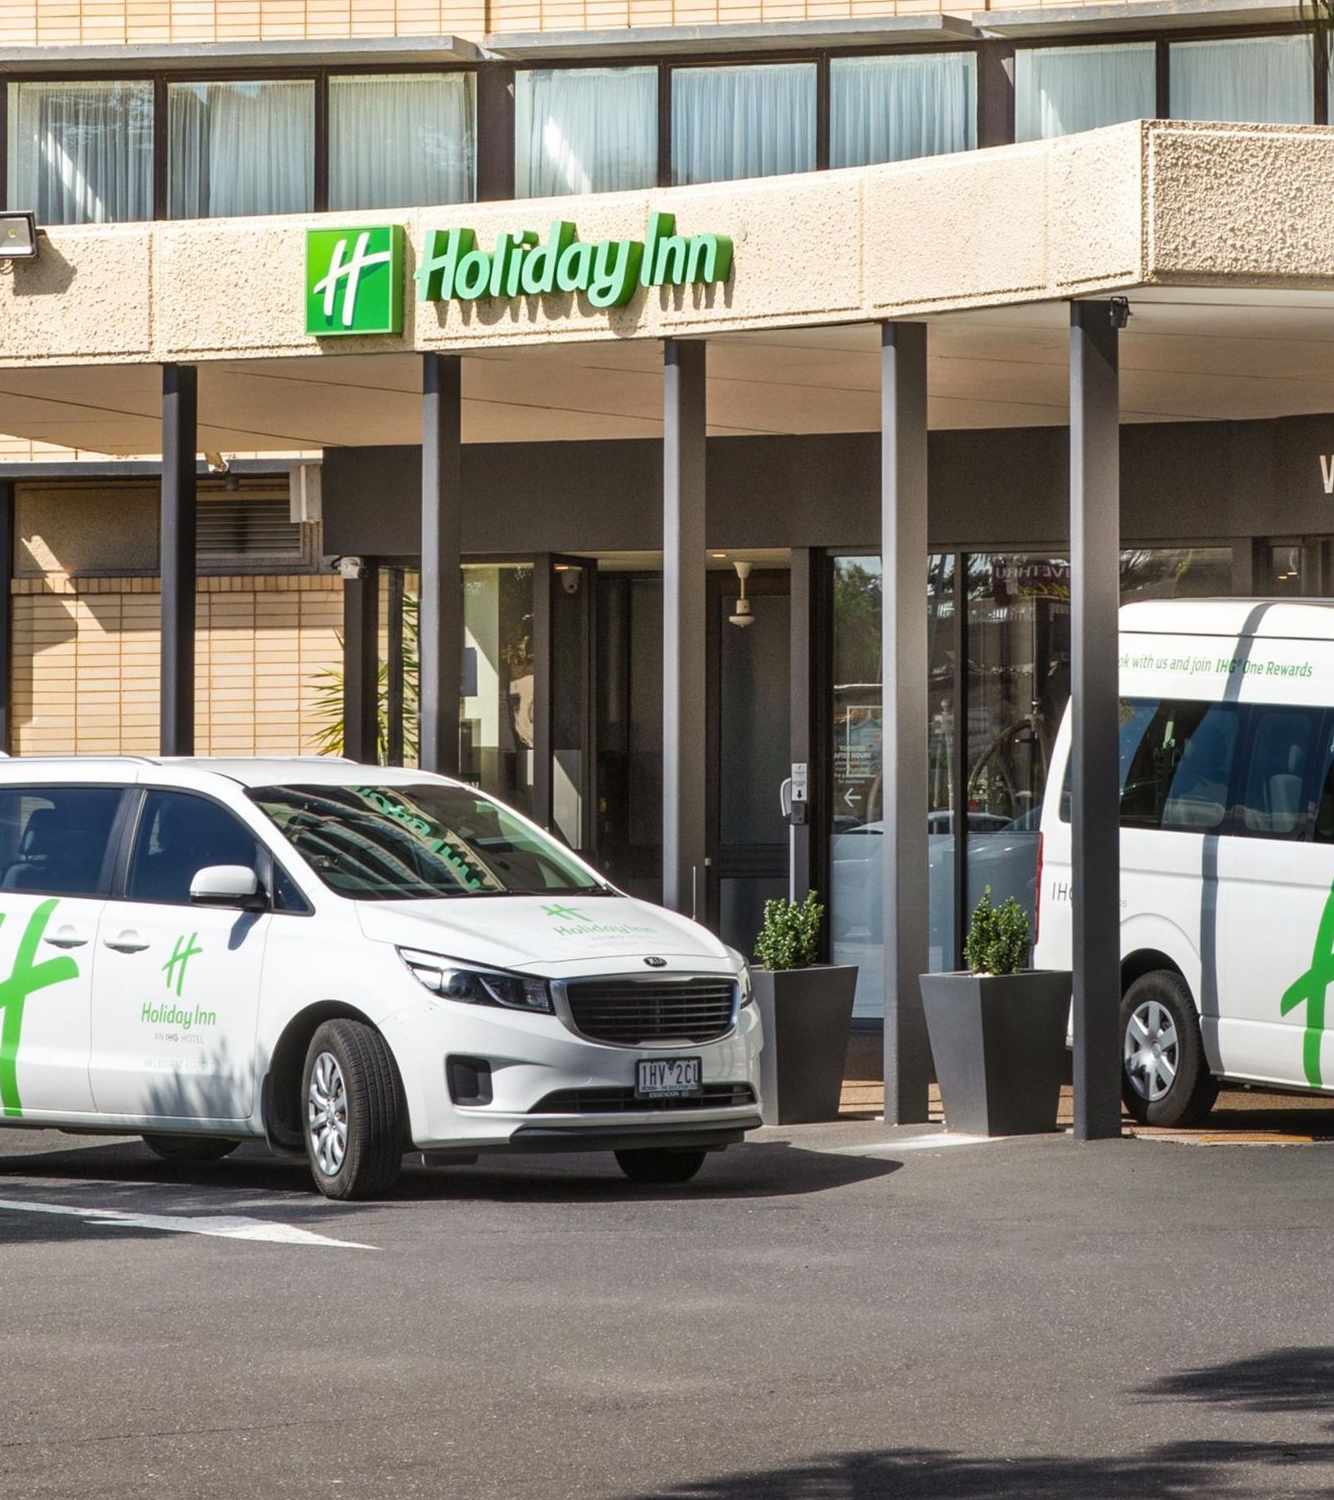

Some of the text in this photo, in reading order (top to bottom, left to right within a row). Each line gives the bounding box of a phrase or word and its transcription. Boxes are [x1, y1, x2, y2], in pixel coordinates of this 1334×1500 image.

[414, 220, 642, 308] Holiday
[640, 211, 733, 288] Inn
[1118, 654, 1130, 669] ok
[1133, 654, 1154, 669] with
[1156, 658, 1168, 670] us
[1170, 656, 1188, 671] and
[1190, 657, 1211, 676] join
[1243, 660, 1263, 675] One
[1266, 661, 1313, 677] Rewards
[553, 924, 630, 936] Holiday
[647, 957, 666, 966] KIA
[141, 1002, 216, 1030] Holiday Inn
[165, 1033, 179, 1042] IHG
[180, 1034, 204, 1044] HOTEL
[643, 1065, 666, 1085] 1HV
